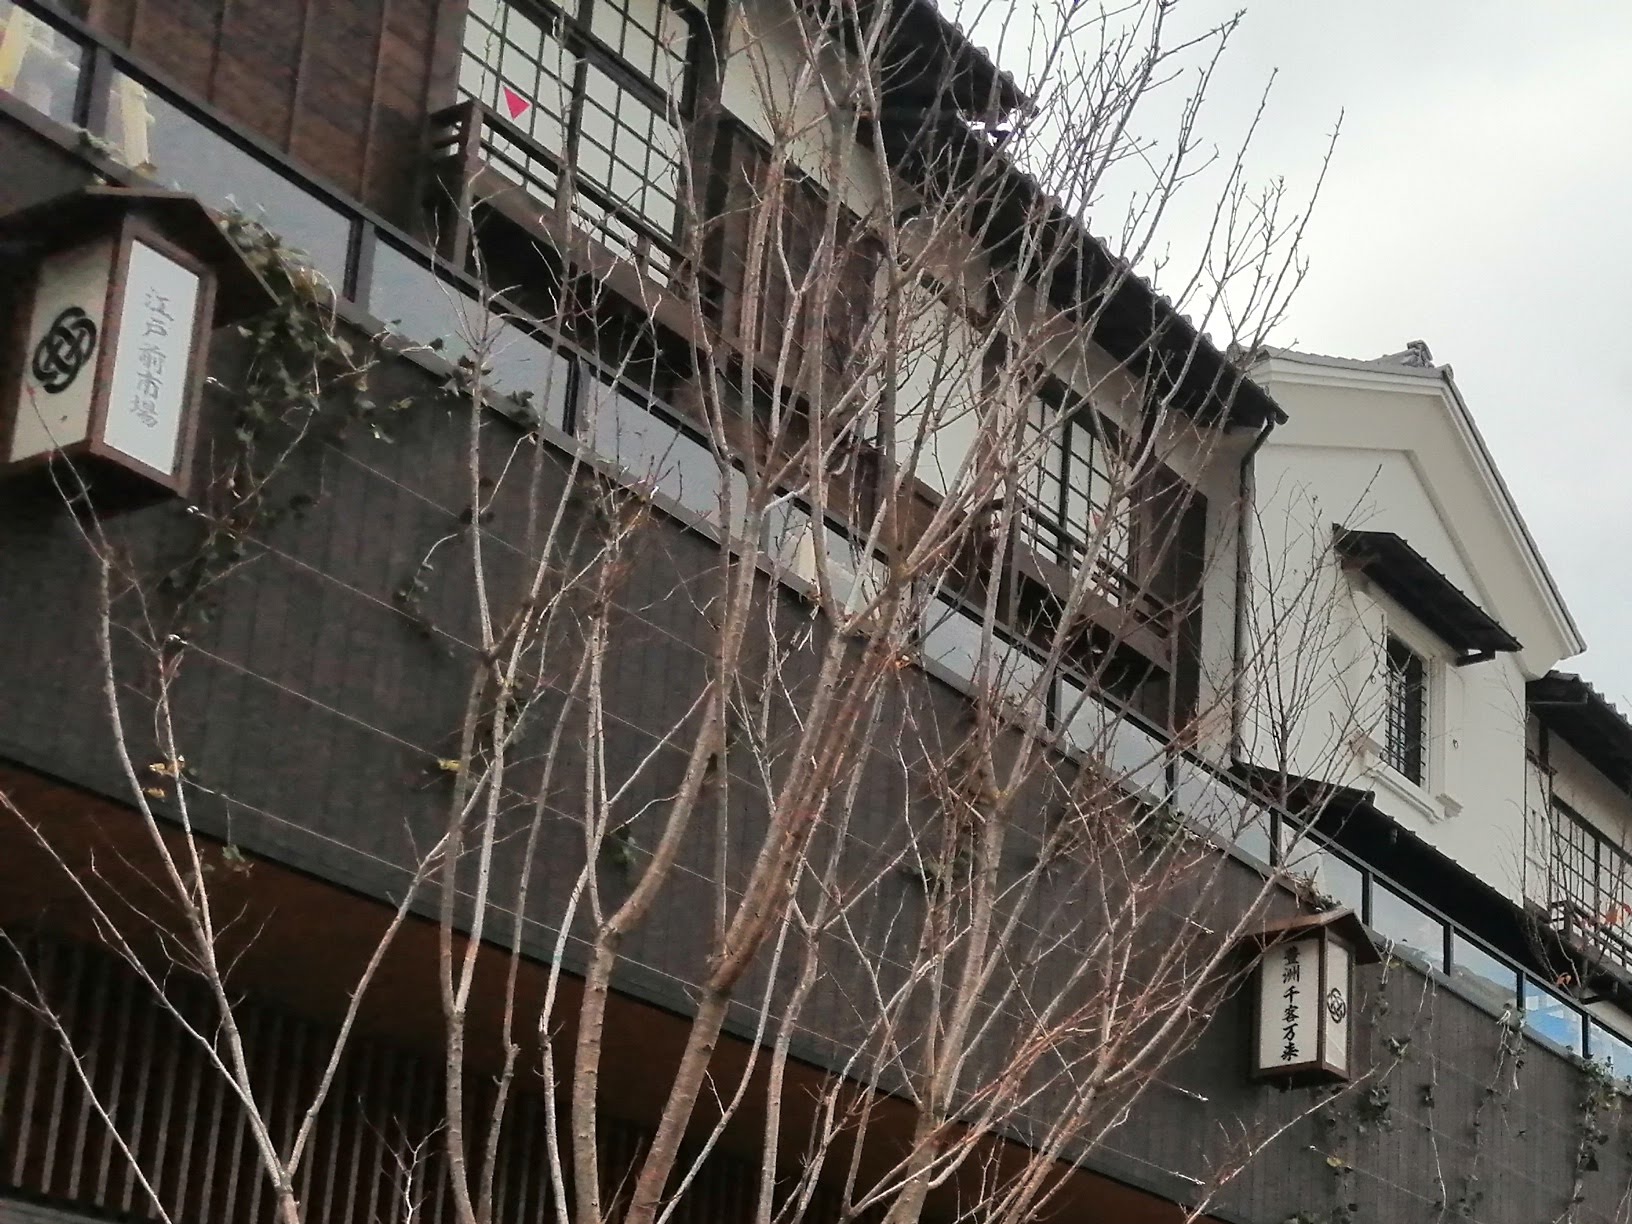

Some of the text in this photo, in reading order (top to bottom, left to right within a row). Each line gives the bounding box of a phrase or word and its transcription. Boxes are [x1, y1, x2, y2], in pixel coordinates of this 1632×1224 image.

[130, 286, 175, 428] 江戸前市場
